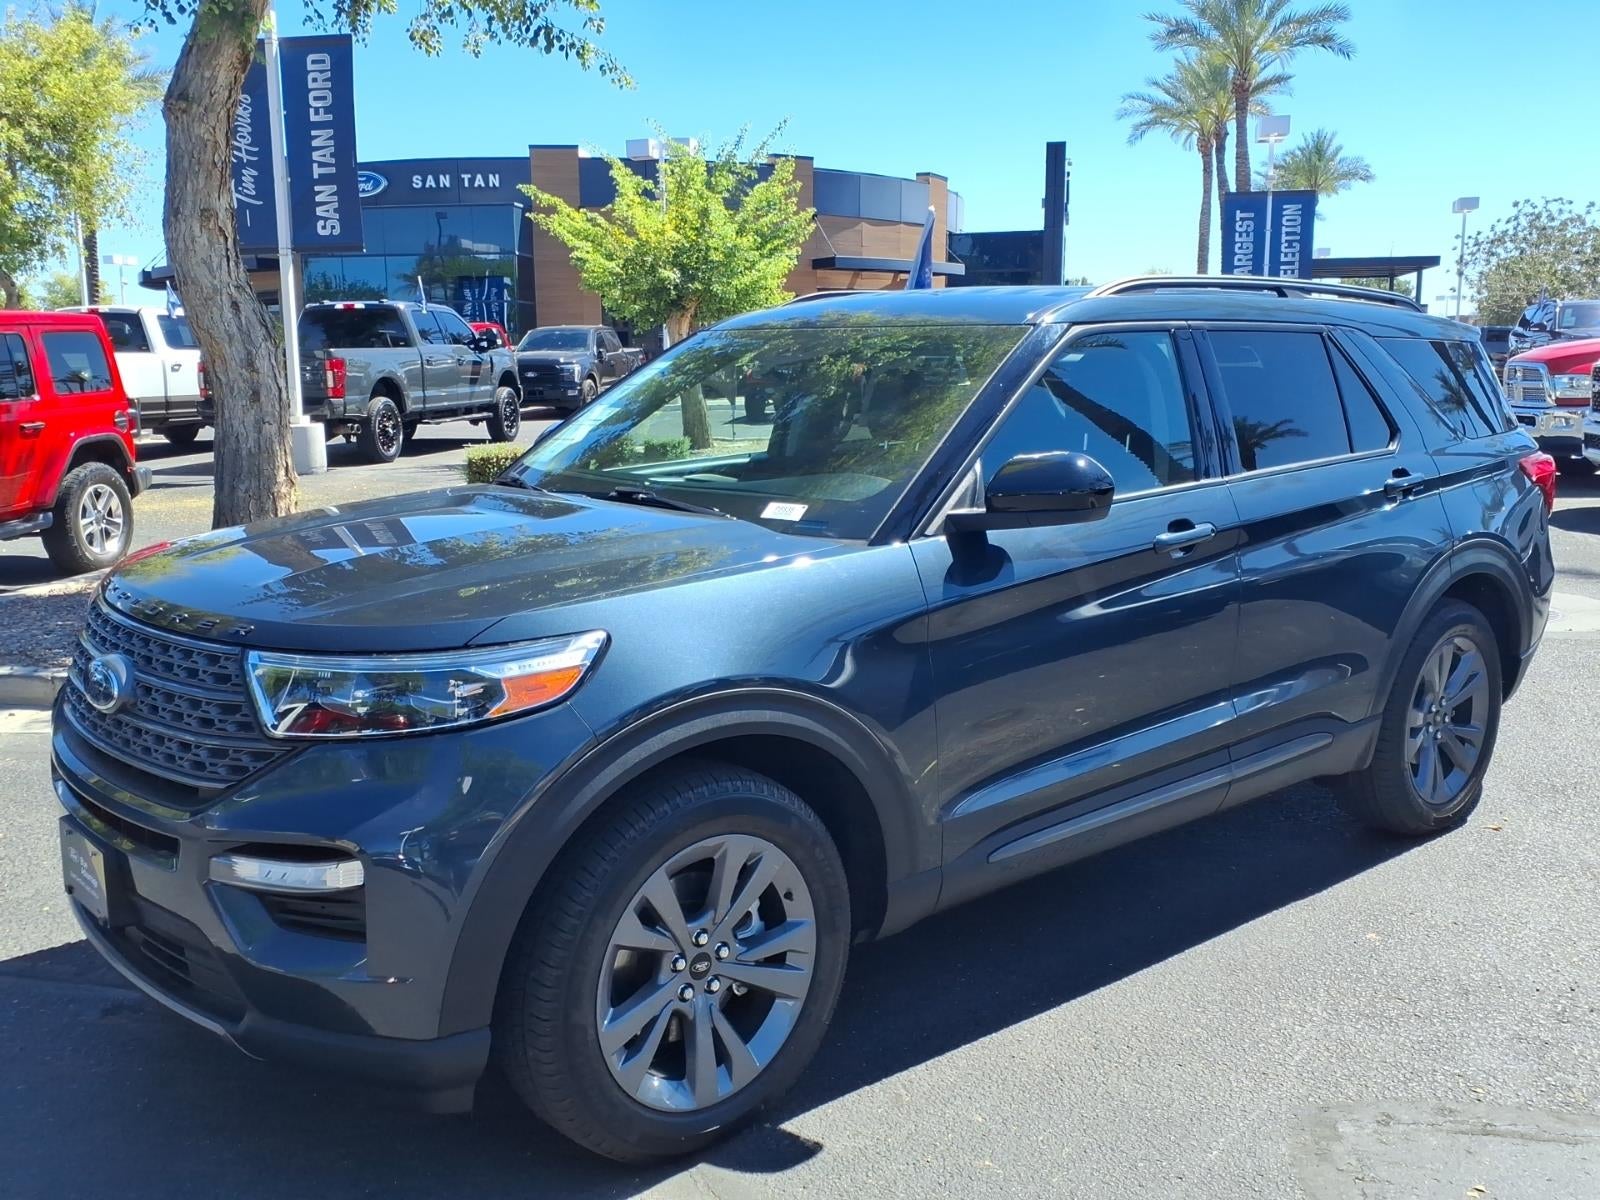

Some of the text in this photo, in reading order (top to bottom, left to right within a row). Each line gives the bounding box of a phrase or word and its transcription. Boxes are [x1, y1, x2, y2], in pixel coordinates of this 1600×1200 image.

[306, 53, 341, 236] SAN TAN FORD
[231, 168, 264, 209] Tim
[411, 173, 500, 189] SAN TAN
[1233, 209, 1255, 276] ARGEST
[1280, 203, 1303, 279] ELECTION
